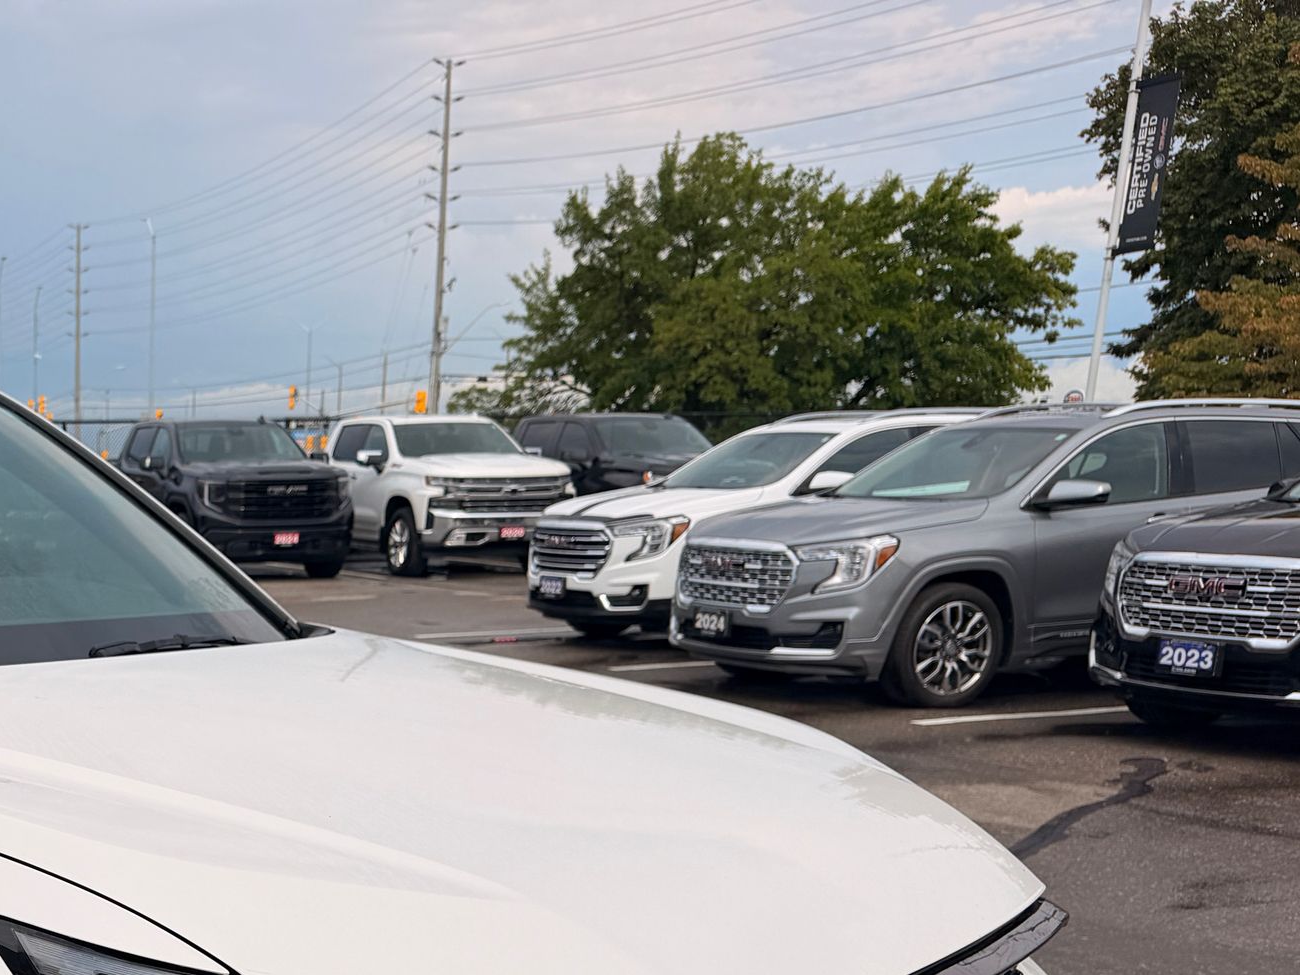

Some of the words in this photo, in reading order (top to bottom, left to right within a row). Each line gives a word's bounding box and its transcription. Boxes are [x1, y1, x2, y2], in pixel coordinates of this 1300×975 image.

[1126, 111, 1150, 215] CERTIFIED
[1136, 115, 1158, 208] PRE-OWNED
[1167, 575, 1245, 598] GMC
[694, 612, 726, 633] 2024
[1159, 646, 1214, 670] 2023
